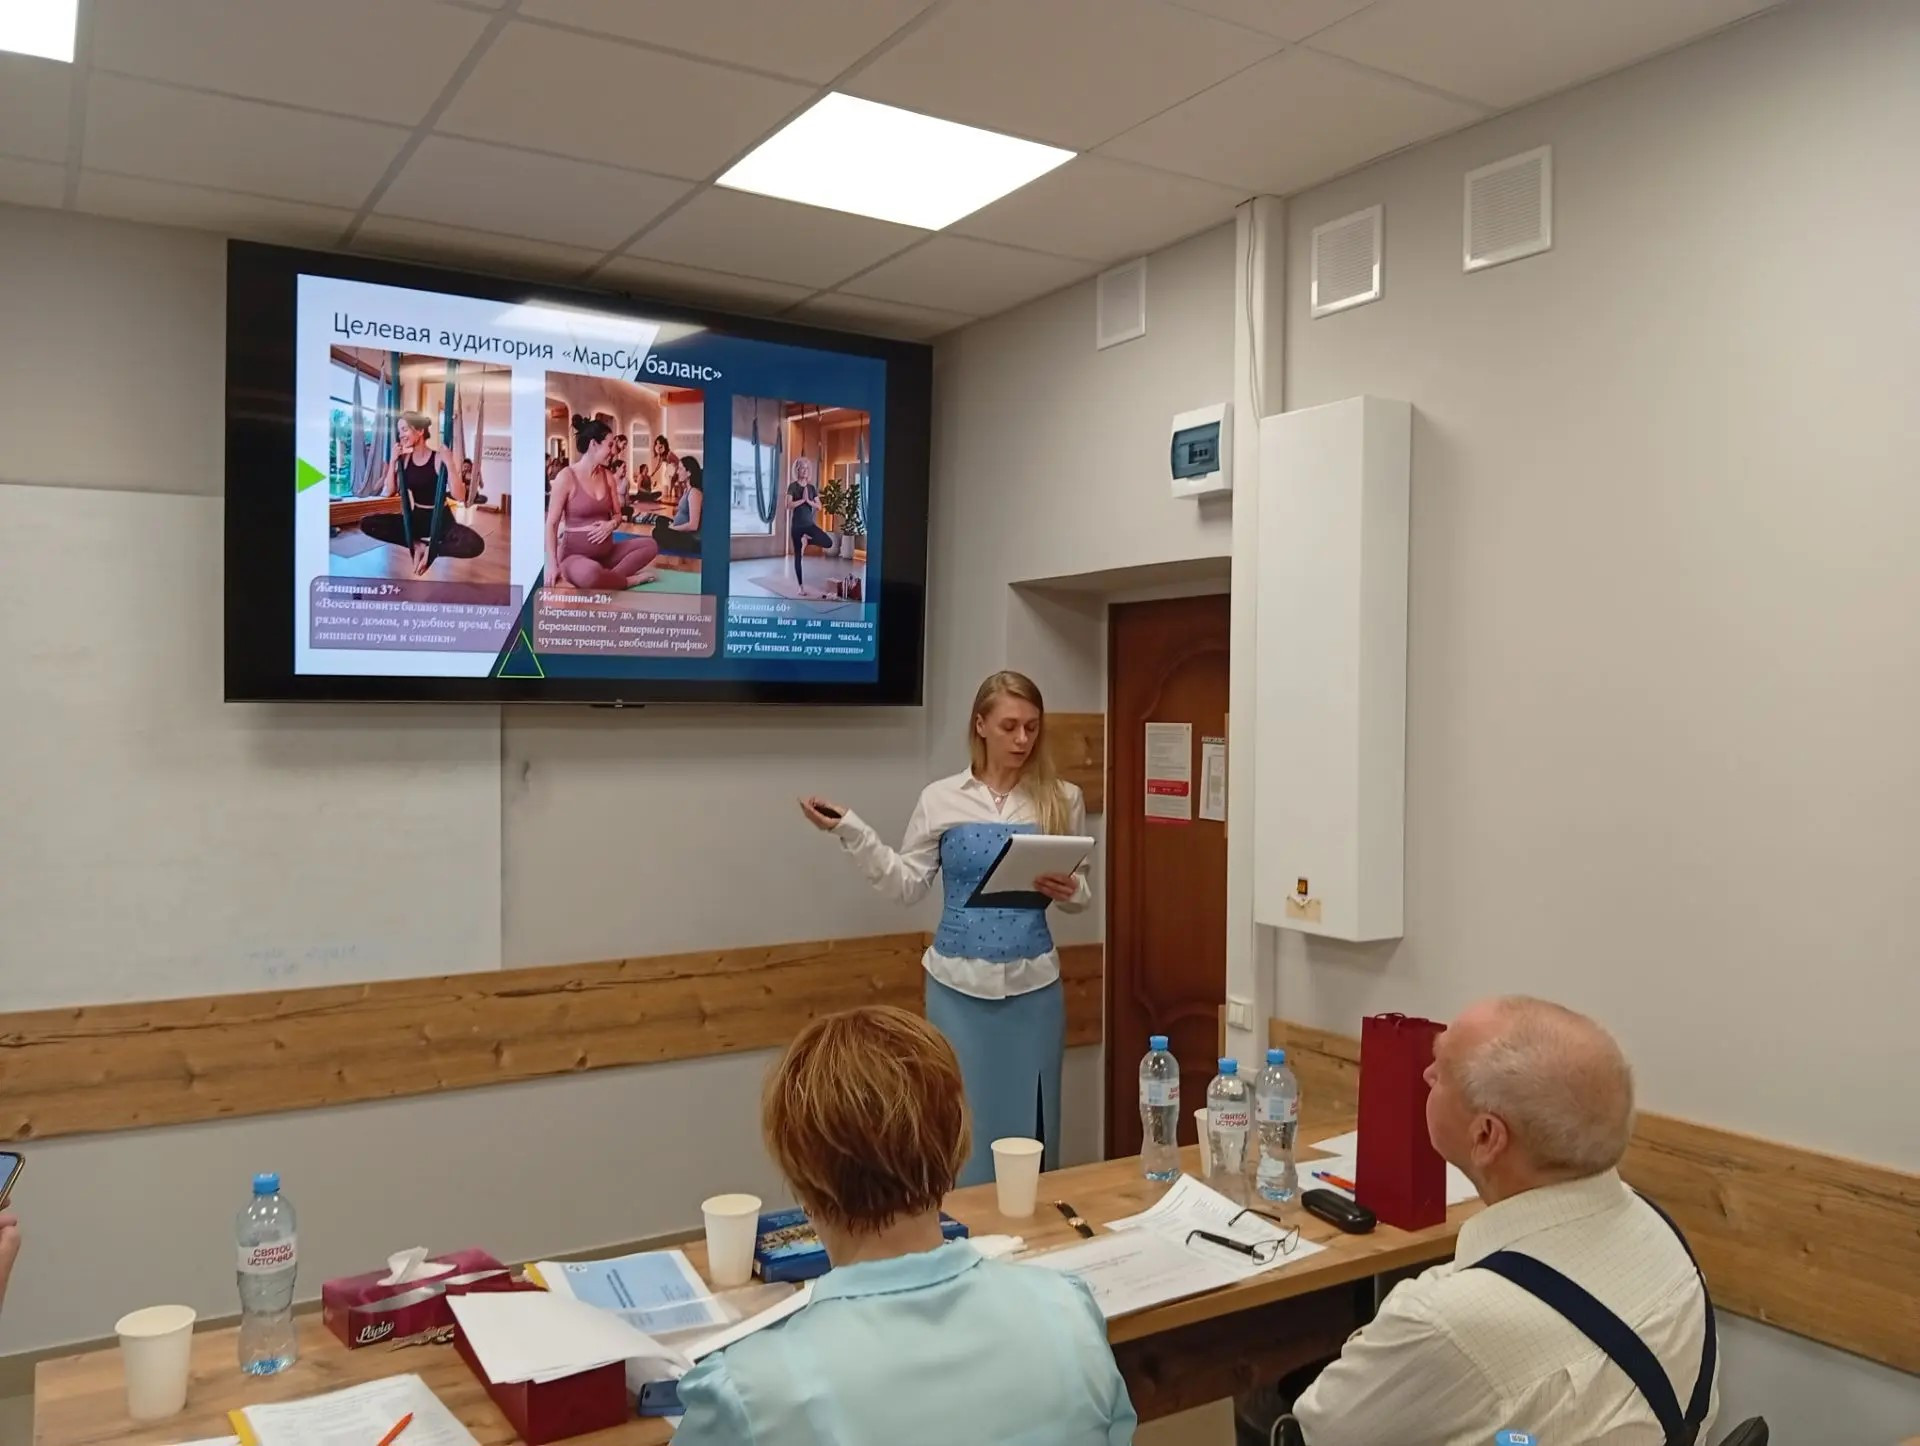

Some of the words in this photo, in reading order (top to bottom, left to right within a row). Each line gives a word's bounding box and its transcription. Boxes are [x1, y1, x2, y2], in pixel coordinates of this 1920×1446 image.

[334, 312, 431, 344] Целевая
[439, 331, 553, 360] аудитория
[562, 345, 640, 372] «МарСи
[645, 354, 722, 382] баланс»
[315, 581, 378, 595] Женщины
[379, 584, 401, 596] 37+
[538, 591, 594, 604] Женщины
[594, 594, 613, 605] 20+
[315, 598, 400, 612] «Восстановите
[401, 601, 438, 613] баланс
[442, 606, 464, 615] тела
[466, 607, 473, 615] и
[776, 603, 791, 613] 60+
[538, 606, 588, 620] «Бережно
[589, 610, 596, 618] к
[597, 611, 618, 622] телу
[620, 612, 634, 621] до,
[636, 612, 648, 621] во
[650, 613, 677, 624] время
[678, 614, 685, 622] и
[686, 614, 713, 624] после
[314, 615, 351, 628] рядом
[352, 618, 360, 626] с
[361, 617, 400, 629] домом,
[403, 619, 410, 628] в
[412, 617, 456, 631] удобное
[458, 621, 492, 633] время,
[494, 619, 512, 631] без
[806, 619, 822, 628] для
[830, 621, 874, 630] активного
[315, 631, 365, 642] лишнего
[366, 632, 398, 644] шума
[400, 634, 408, 644] и
[409, 635, 457, 645] спешки»
[619, 625, 665, 637] камерные
[666, 627, 702, 639] группы,
[792, 632, 832, 643] утренние
[837, 633, 862, 643] часы,
[538, 637, 573, 648] чуткие
[574, 638, 617, 650] тренеры,
[618, 638, 669, 650] свободный
[670, 639, 709, 652] график»
[727, 643, 753, 655] кругу
[754, 642, 790, 653] близких
[791, 645, 803, 653] по
[804, 645, 822, 656] духу
